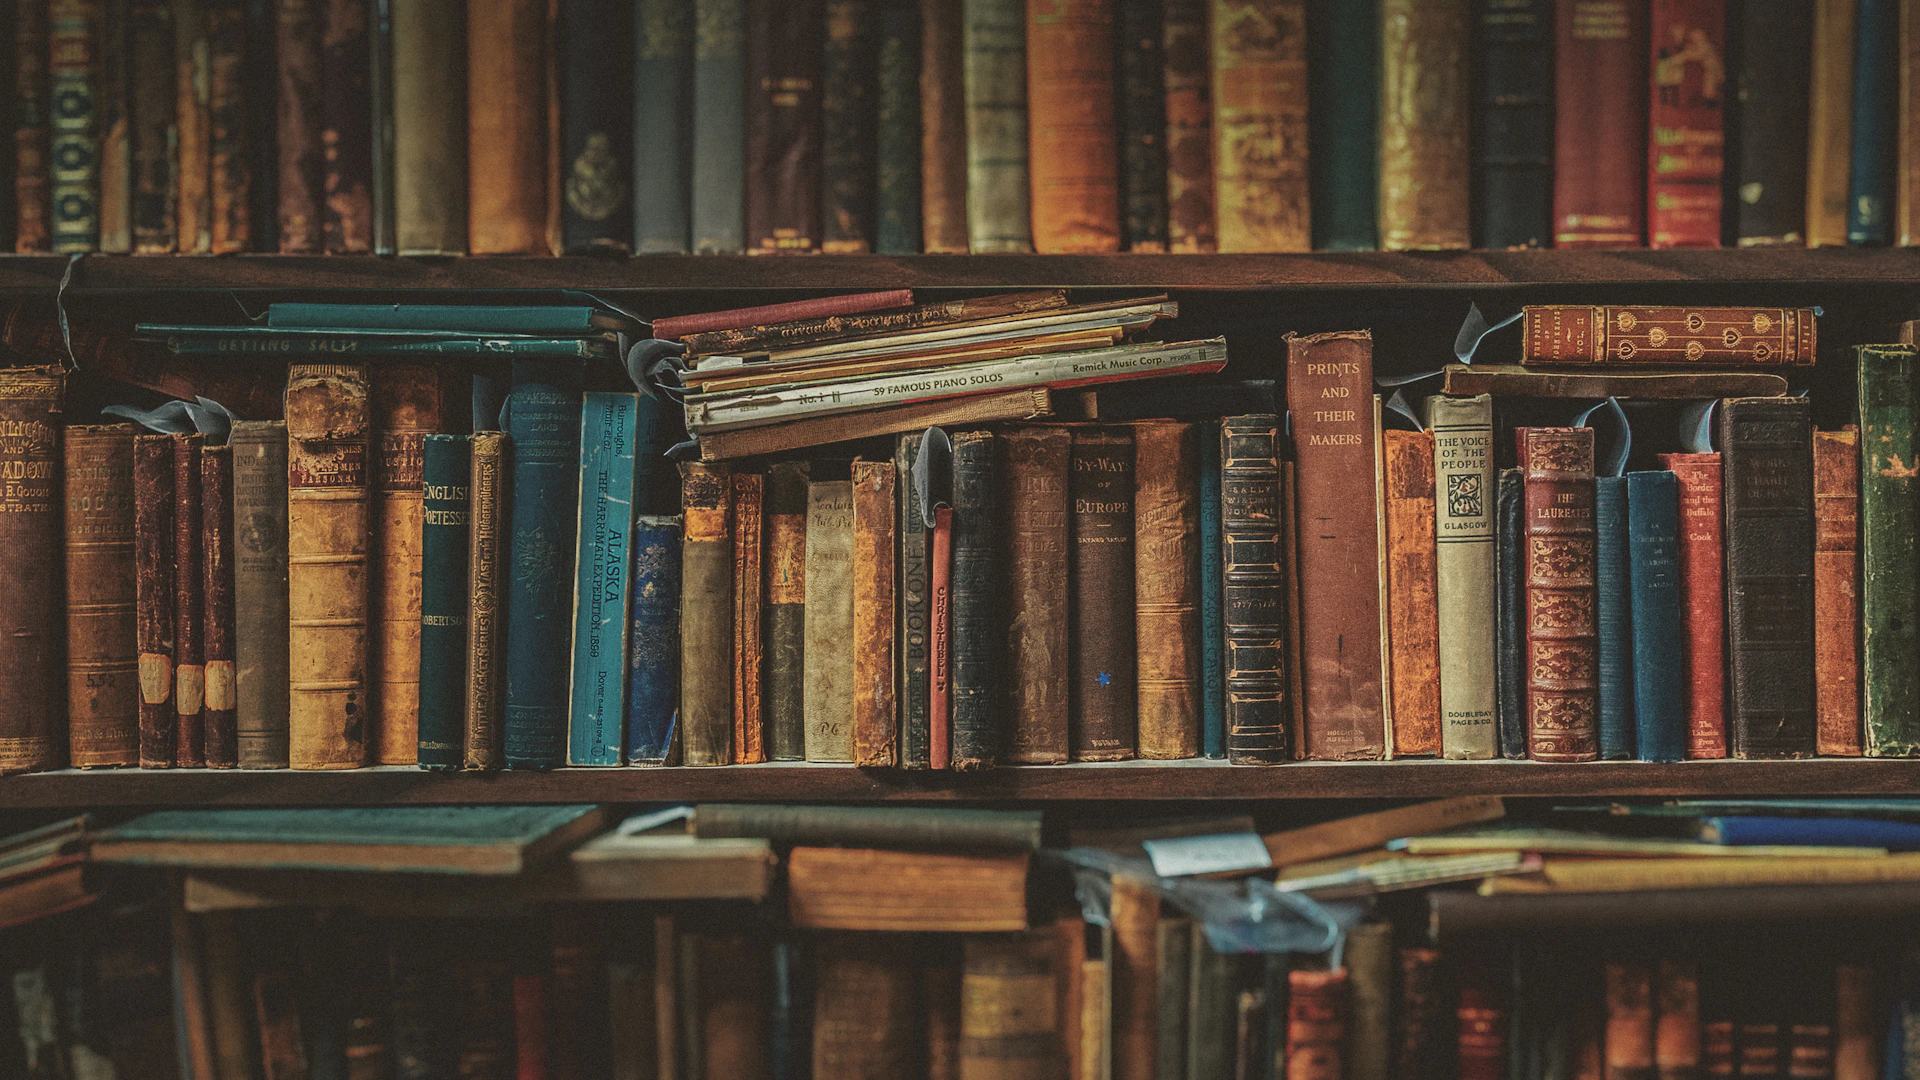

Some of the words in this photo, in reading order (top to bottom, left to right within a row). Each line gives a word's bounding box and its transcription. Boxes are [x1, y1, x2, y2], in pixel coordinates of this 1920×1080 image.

[1577, 317, 1584, 325] II
[1545, 330, 1550, 339] OF
[218, 339, 290, 351] GETTING
[1073, 360, 1107, 373] Remick
[1109, 358, 1137, 369] Music
[1139, 355, 1166, 368] Corp.
[1307, 362, 1360, 375] PRINTS
[874, 387, 885, 396] 59
[887, 381, 931, 394] FAMOUS
[934, 377, 967, 389] PIANO
[970, 373, 1003, 385] SOLOS
[1320, 386, 1350, 399] AND
[799, 394, 817, 405] No.
[604, 403, 614, 427] Muir
[1313, 410, 1356, 422] THEIR
[614, 404, 627, 457] Burroughs,
[1309, 434, 1363, 446] MAKERS
[1437, 438, 1458, 447] THE
[1461, 436, 1489, 446] VOICE
[3, 446, 24, 454] AND
[1442, 449, 1457, 458] OF
[1464, 448, 1485, 457] THE
[0, 461, 54, 479] ADOW
[1441, 460, 1486, 470] PEOPLE
[1691, 470, 1709, 479] The
[598, 471, 607, 494] THE
[1687, 483, 1714, 492] Border
[1556, 493, 1575, 503] THE
[1685, 495, 1700, 504] and
[1702, 495, 1715, 504] the
[1076, 498, 1129, 514] EUROPE
[1686, 507, 1715, 516] Buffalo
[423, 506, 470, 526] POETESSE
[1537, 507, 1590, 518] LAUREATES
[593, 497, 606, 562] HARRIMAN
[1444, 521, 1487, 530] GLASGOW
[1689, 532, 1712, 541] Cook
[605, 528, 622, 603] ALASKA
[908, 547, 924, 594] ONE
[908, 599, 925, 659] BOOK
[936, 586, 947, 677] CHRISTABEL
[477, 617, 491, 656] SERIES
[590, 632, 600, 658] 1899
[85, 673, 116, 687] 552
[599, 670, 607, 698] Dover
[1698, 720, 1714, 728] The
